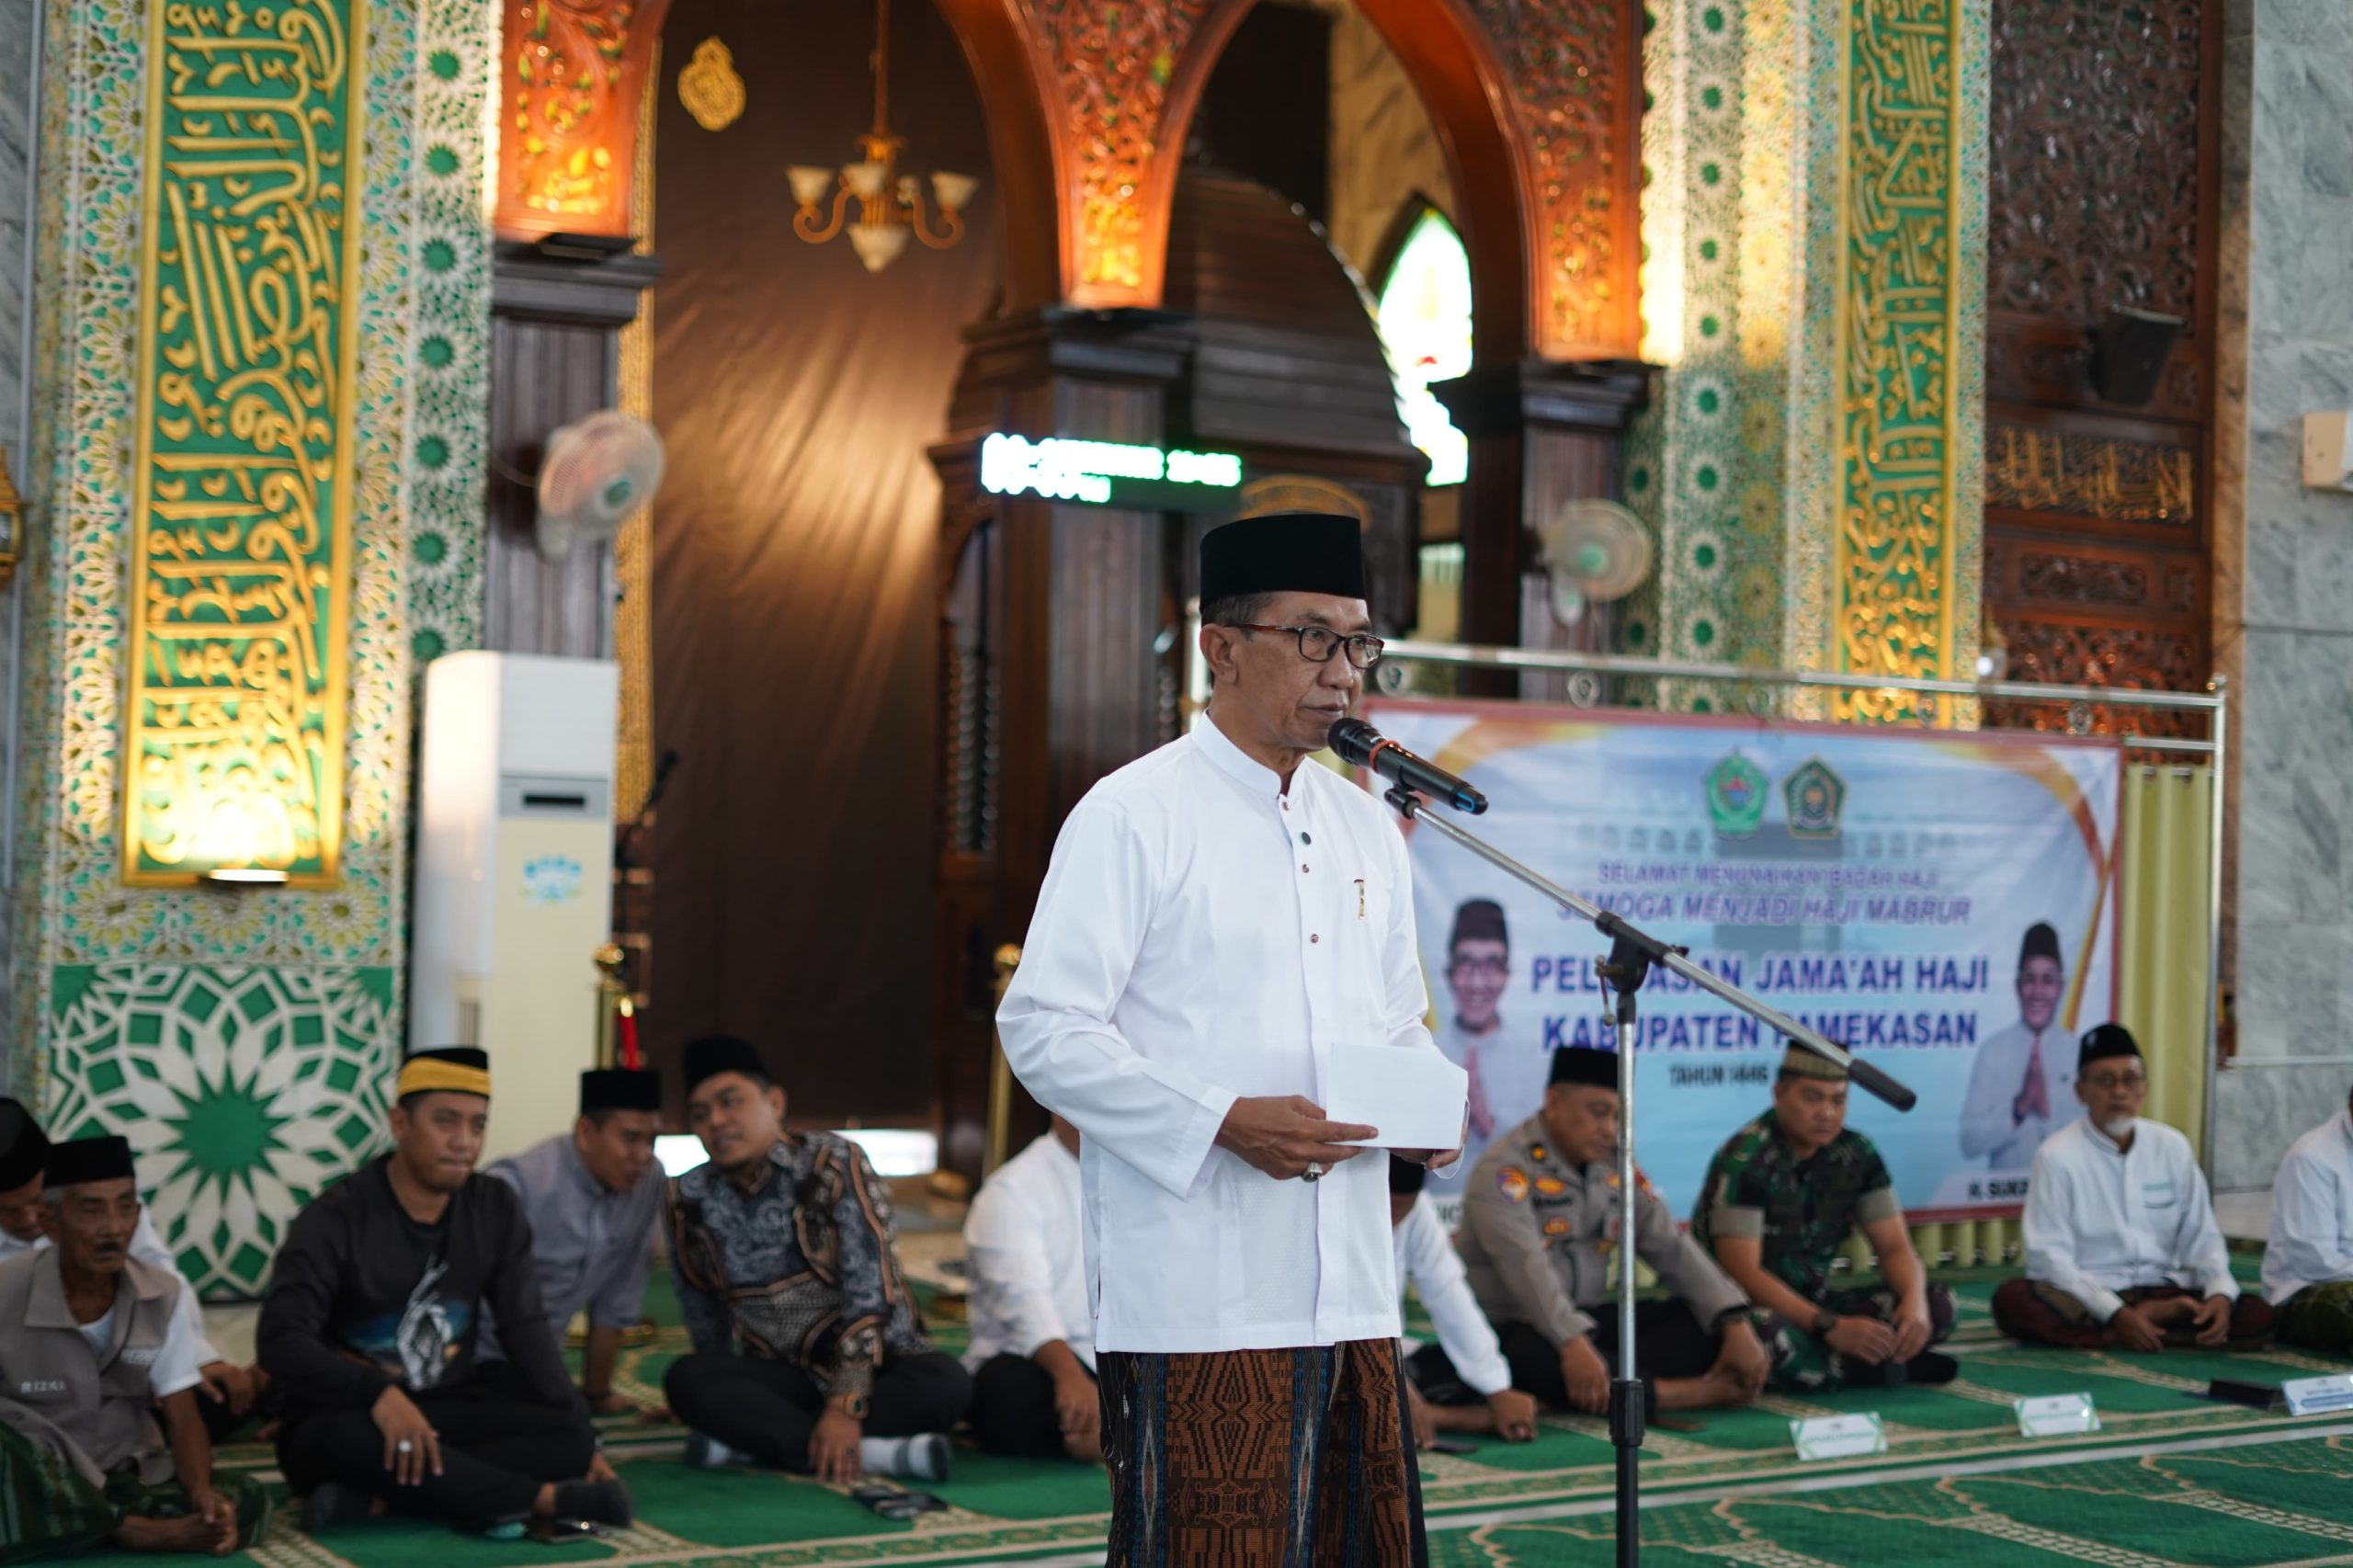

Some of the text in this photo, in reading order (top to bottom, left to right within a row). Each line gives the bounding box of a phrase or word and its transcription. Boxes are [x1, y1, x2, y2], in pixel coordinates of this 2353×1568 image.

[1597, 860, 1688, 883] SELAMAT
[1684, 892, 1796, 924] MENJADI
[1803, 893, 1859, 925] HAJI
[1866, 894, 1972, 926] MABRUR
[1755, 959, 1904, 991] JAMA'AH
[1915, 958, 1989, 991] HAJI
[1774, 1013, 1976, 1046] MEKASAN
[1669, 1063, 1723, 1086] TAHUN
